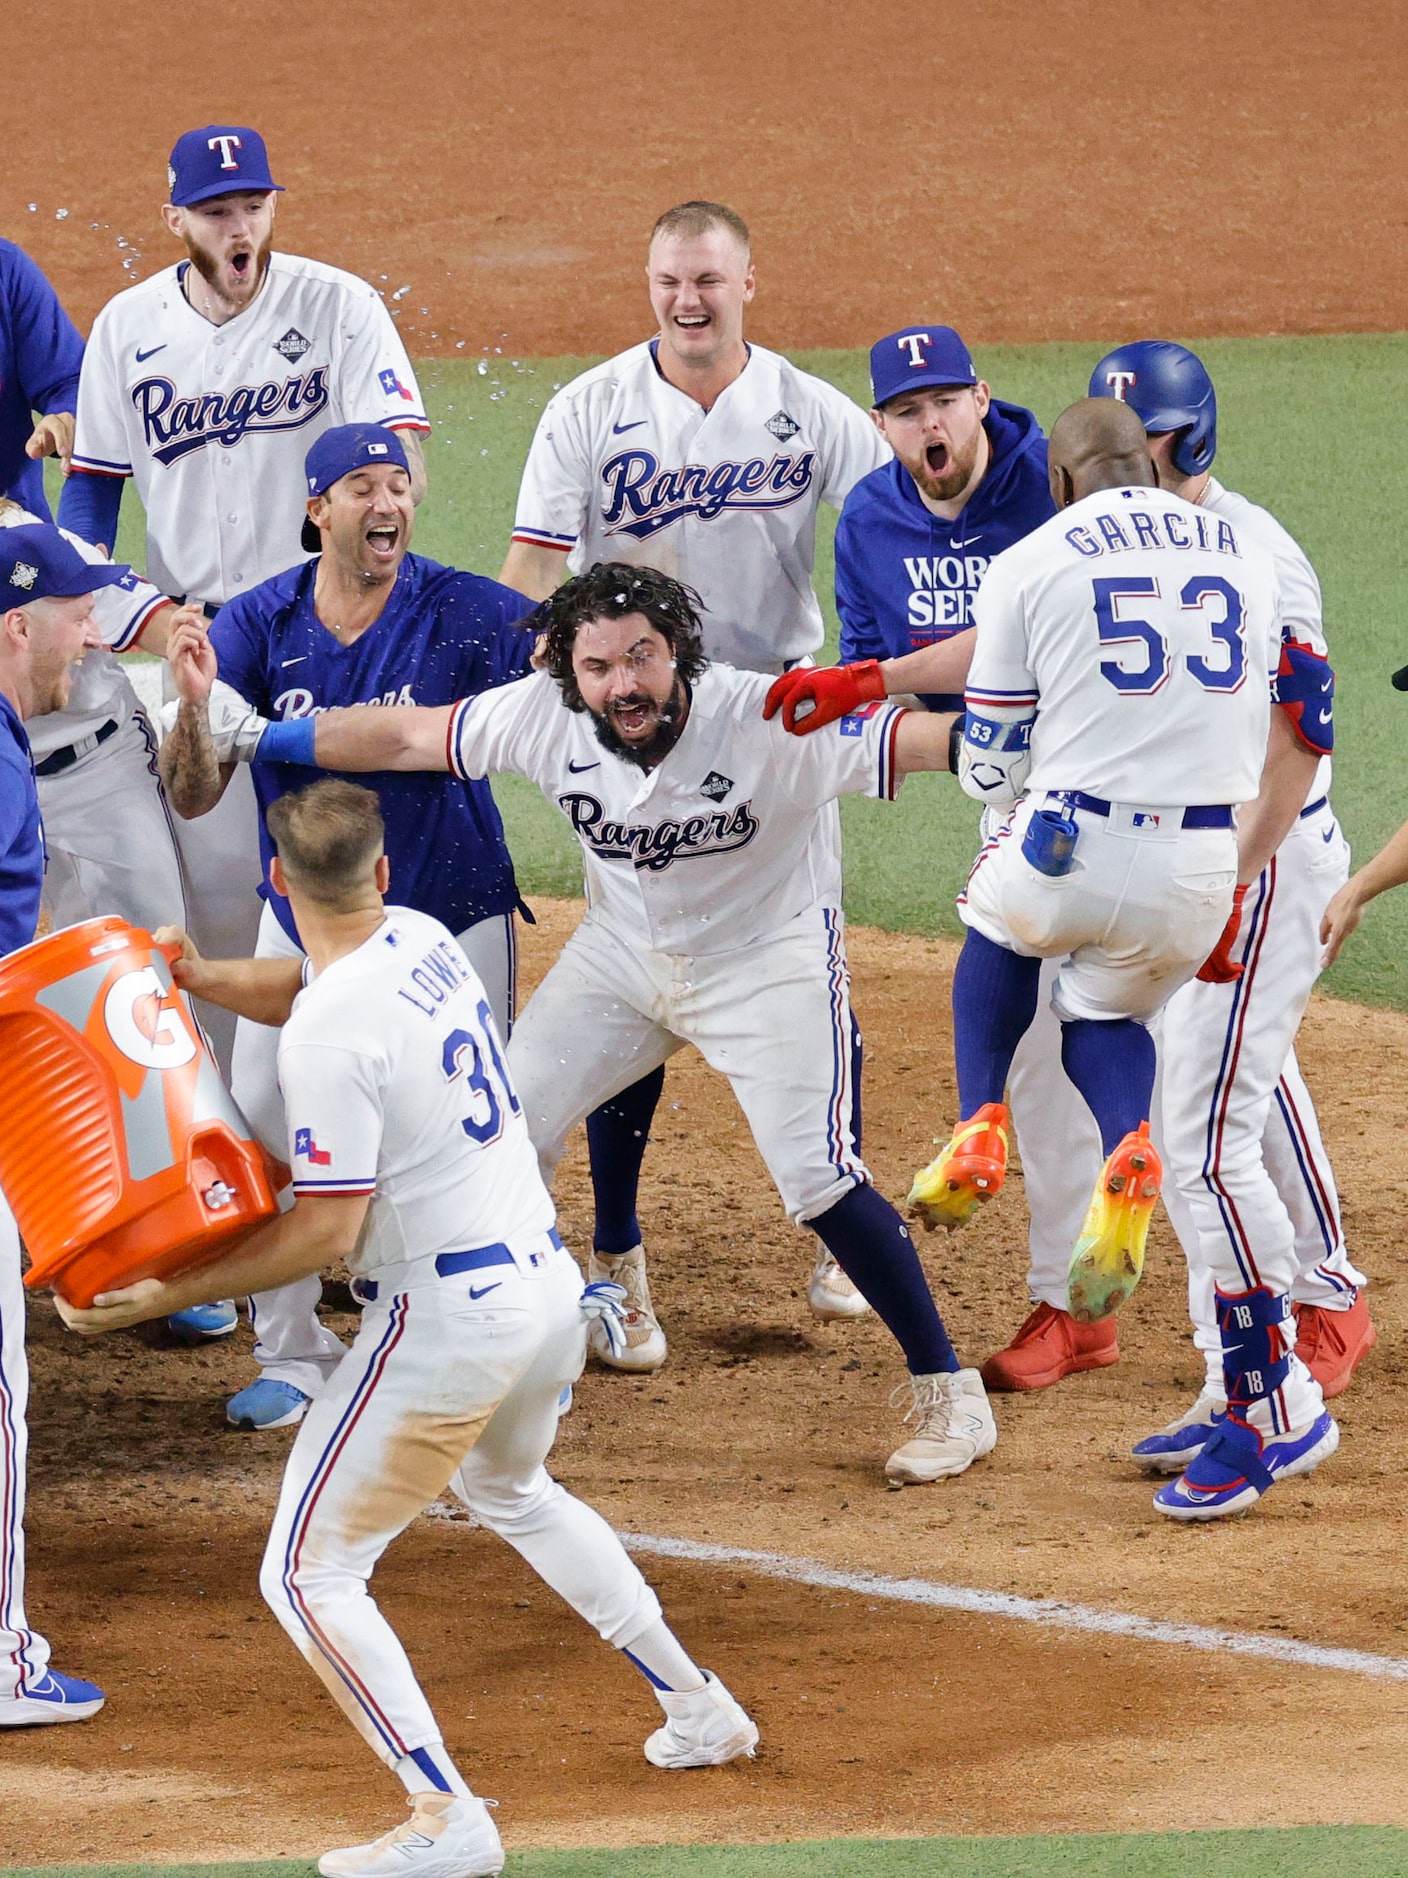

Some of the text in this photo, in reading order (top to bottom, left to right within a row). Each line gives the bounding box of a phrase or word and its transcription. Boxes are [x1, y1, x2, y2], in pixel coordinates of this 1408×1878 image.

[207, 135, 243, 170] T
[897, 333, 933, 368] T
[1107, 372, 1136, 403] T
[132, 365, 330, 469] Rangers
[600, 448, 816, 541] Rangers
[1065, 512, 1243, 559] GARCIA
[903, 555, 996, 590] WOR
[1092, 576, 1248, 695] 53
[969, 721, 992, 743] 53
[557, 799, 760, 873] Rangers
[398, 941, 470, 1021] LOWE
[104, 964, 197, 1070] G
[1233, 1305, 1253, 1329] 18
[1244, 1370, 1265, 1394] 18
